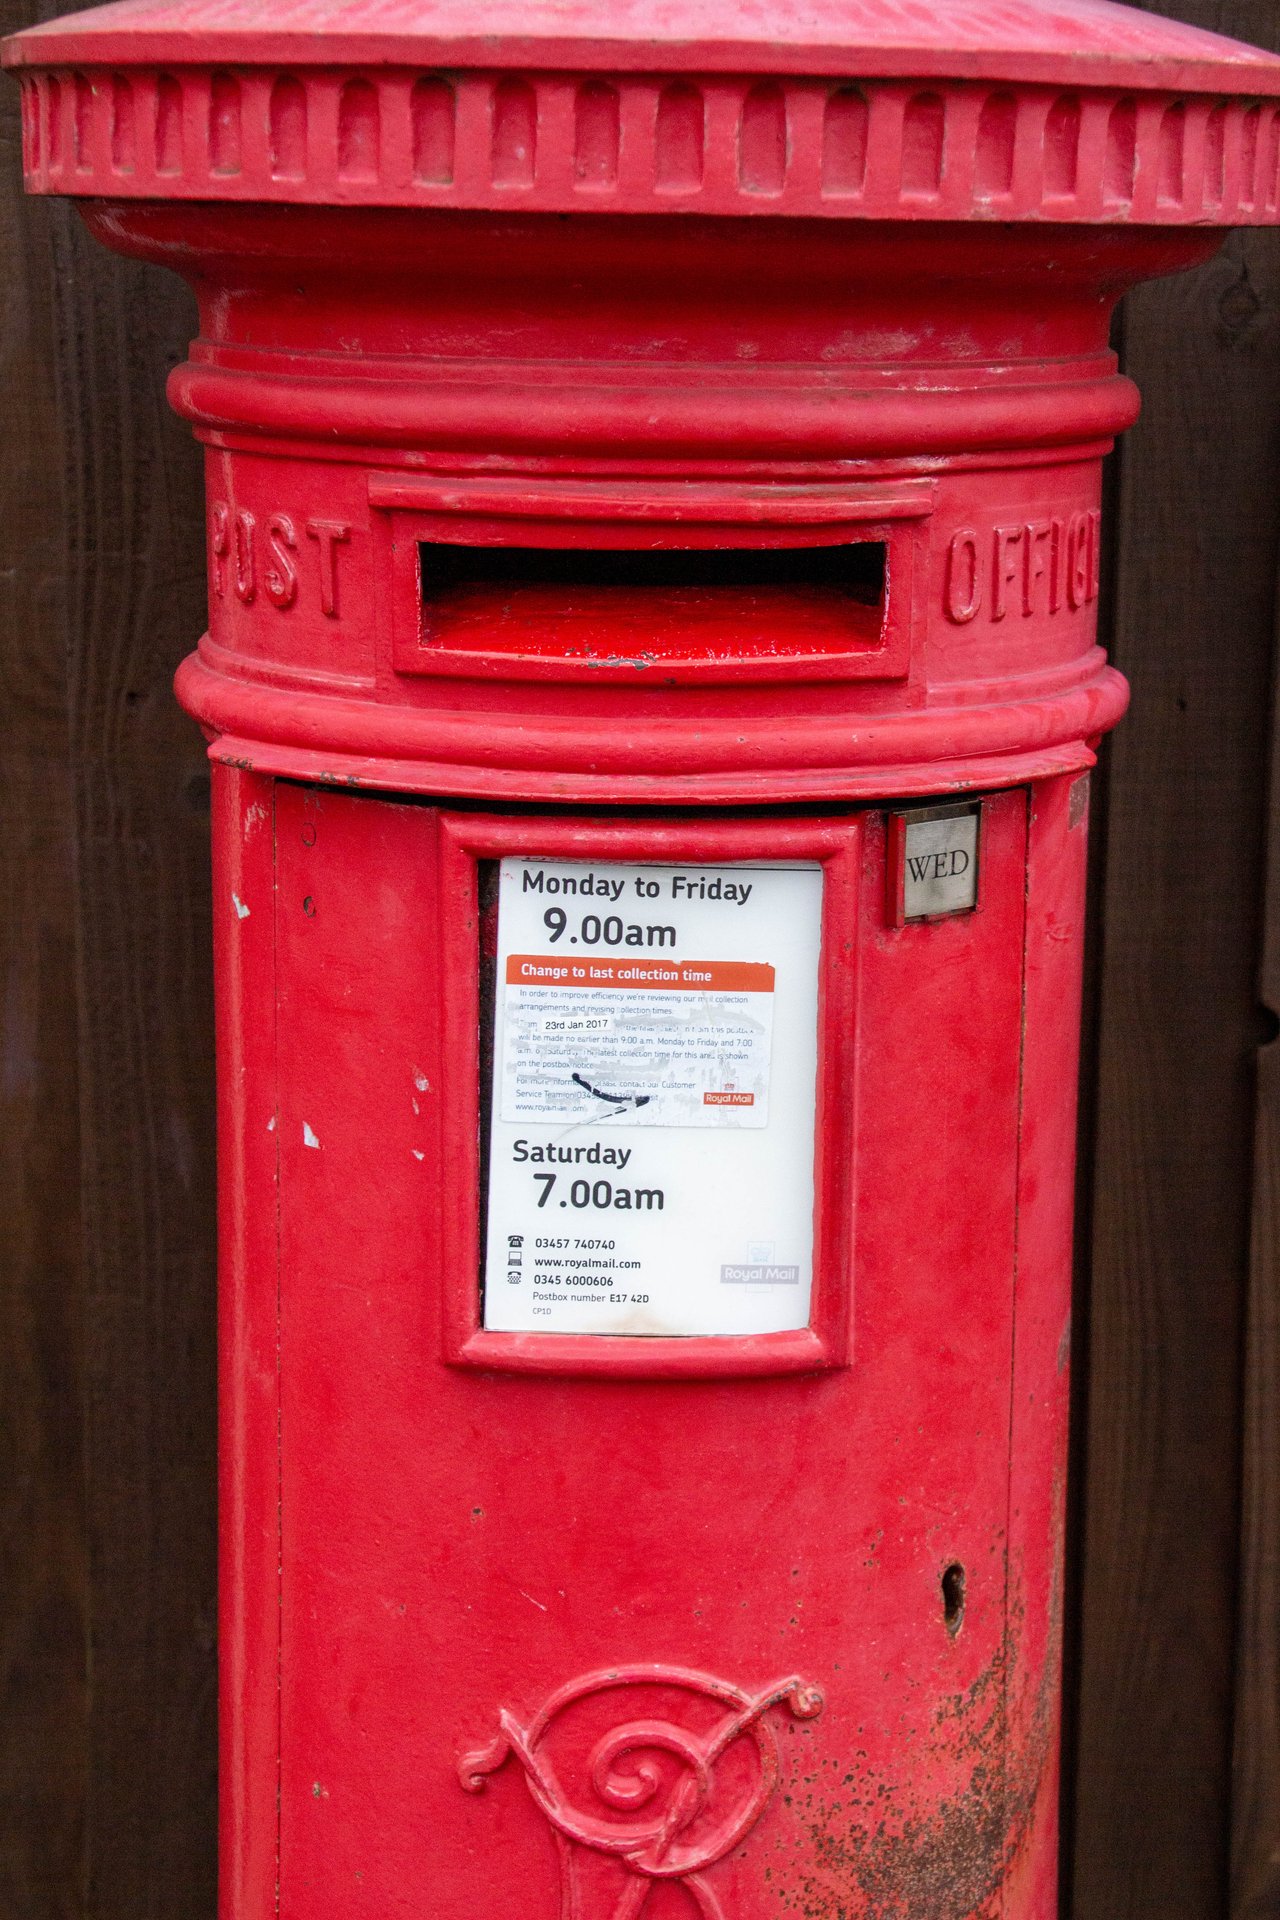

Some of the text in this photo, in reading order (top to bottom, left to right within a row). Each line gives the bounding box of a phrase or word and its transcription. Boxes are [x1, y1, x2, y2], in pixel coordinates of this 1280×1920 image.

[906, 849, 969, 883] WED
[522, 869, 753, 906] Monday to Friday
[543, 906, 676, 947] 9.00am
[521, 963, 712, 982] Change to last collection time
[520, 989, 527, 997] In
[529, 990, 549, 998] order
[551, 991, 558, 999] to
[560, 991, 589, 1001] improve
[591, 991, 625, 1002] efficiency
[626, 992, 646, 1001] we're
[647, 993, 681, 1004] reviewing
[715, 994, 749, 1004] collection
[519, 1003, 570, 1013] arrangements
[572, 1004, 586, 1012] and
[587, 1005, 615, 1015] revising
[616, 1006, 651, 1015] ollection
[545, 1019, 609, 1030] 23rd Jan 2017
[517, 1033, 531, 1042] will
[532, 1034, 542, 1042] be
[543, 1034, 564, 1043] made
[565, 1035, 576, 1043] no
[577, 1035, 600, 1044] earlier
[602, 1036, 619, 1044] than
[657, 1036, 685, 1047] Monday
[687, 1038, 695, 1046] to
[696, 1038, 718, 1048] Friday
[720, 1039, 734, 1047] and
[599, 1049, 618, 1057] latest
[619, 1050, 653, 1059] collection
[655, 1051, 669, 1059] time
[672, 1051, 683, 1059] for
[684, 1051, 698, 1060] this
[725, 1052, 749, 1061] shown
[517, 1060, 527, 1068] on
[528, 1060, 541, 1069] the
[542, 1060, 570, 1072] postbox
[661, 1081, 697, 1090] Customer
[516, 1089, 543, 1099] Service
[544, 1090, 562, 1099] Team
[706, 1094, 753, 1104] Royal Mail
[513, 1139, 632, 1170] Saturday
[533, 1173, 664, 1210] 7.00am
[535, 1238, 616, 1250] 03457 740740
[534, 1258, 641, 1270] www.royalmail.com
[533, 1274, 614, 1287] 0345 6000606
[725, 1267, 795, 1282] Royal Mail
[532, 1291, 650, 1304] Postbox number E17 42D
[532, 1307, 552, 1316] CP1D
